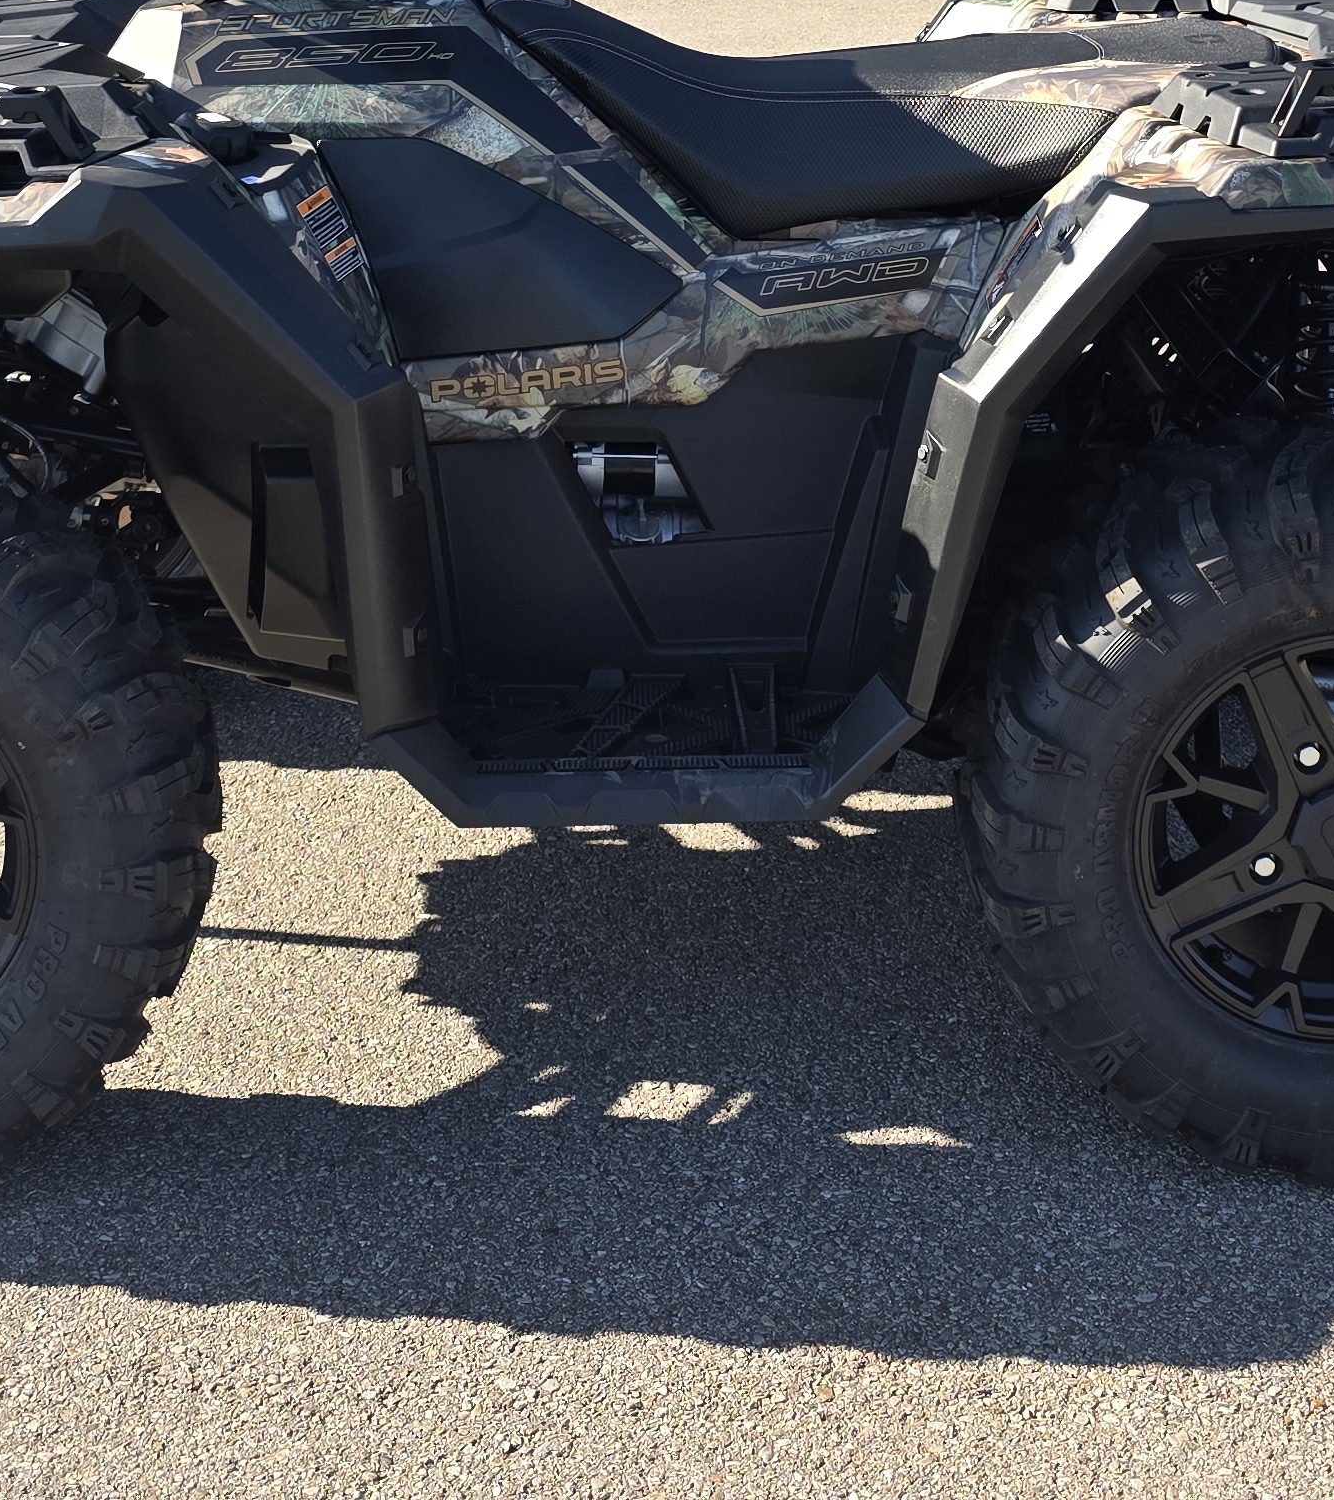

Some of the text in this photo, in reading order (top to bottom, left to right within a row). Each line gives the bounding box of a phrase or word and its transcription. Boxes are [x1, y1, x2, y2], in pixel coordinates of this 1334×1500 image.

[218, 7, 457, 33] SPORTSMAN
[215, 41, 438, 73] 850
[758, 241, 926, 271] ON DEMAND
[759, 256, 930, 296] AWD
[429, 357, 625, 403] POLARIS
[21, 921, 70, 1005] PRO
